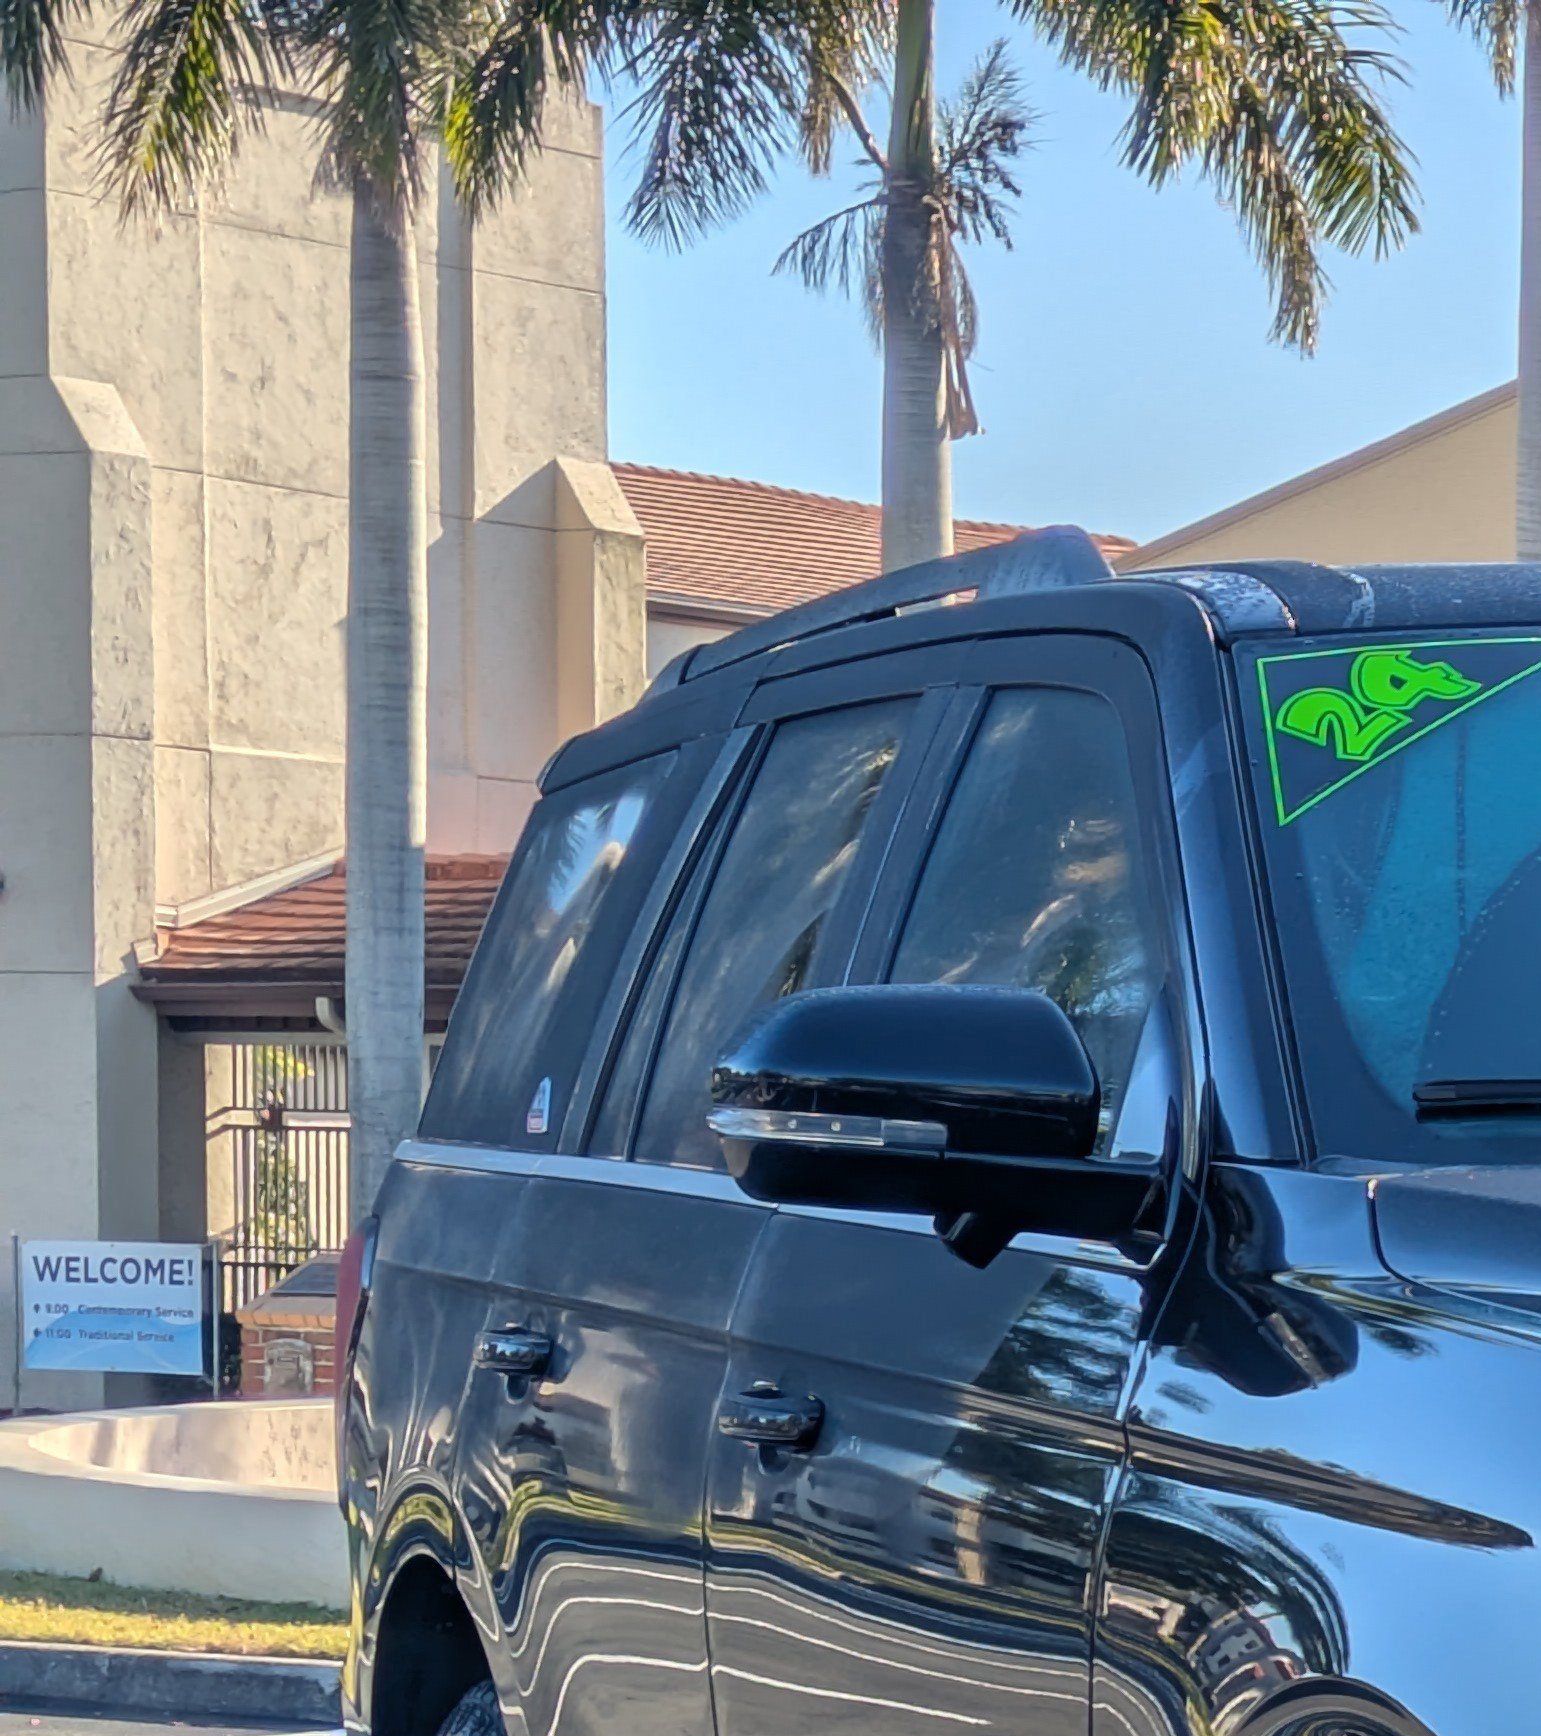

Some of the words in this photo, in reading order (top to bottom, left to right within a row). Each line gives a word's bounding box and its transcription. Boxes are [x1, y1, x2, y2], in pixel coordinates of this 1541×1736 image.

[32, 1255, 194, 1286] WELCOME!
[155, 1306, 194, 1319] Service
[78, 1329, 134, 1342] Traditional
